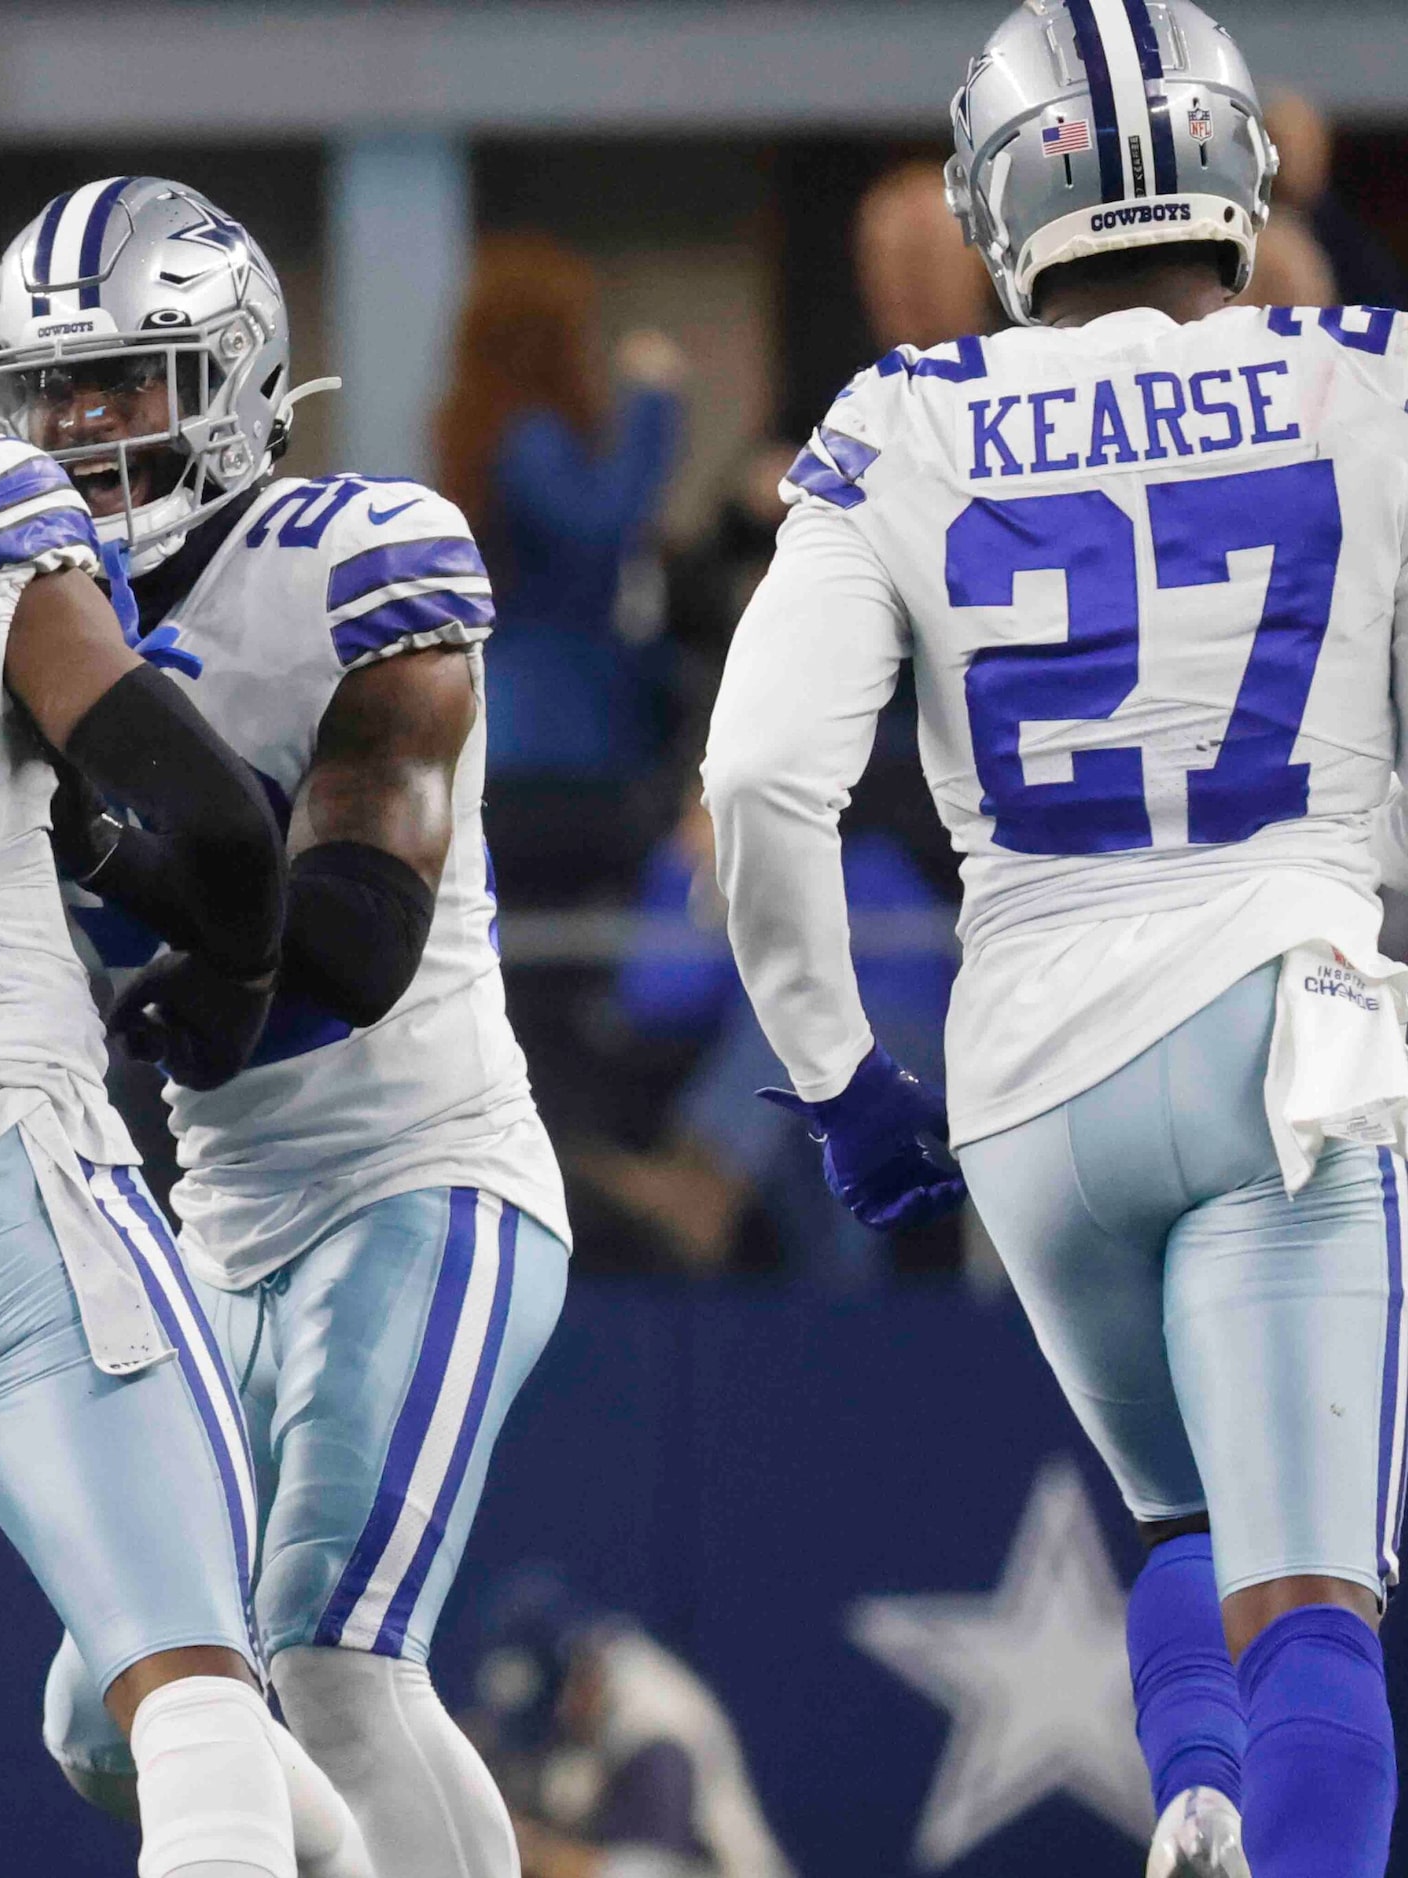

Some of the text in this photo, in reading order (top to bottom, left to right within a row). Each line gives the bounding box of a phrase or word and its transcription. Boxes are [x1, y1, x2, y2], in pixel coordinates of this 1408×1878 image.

[1191, 121, 1210, 138] NFL
[1091, 203, 1191, 232] COWBOYS
[968, 360, 1301, 480] KEARSE
[946, 459, 1343, 855] 27
